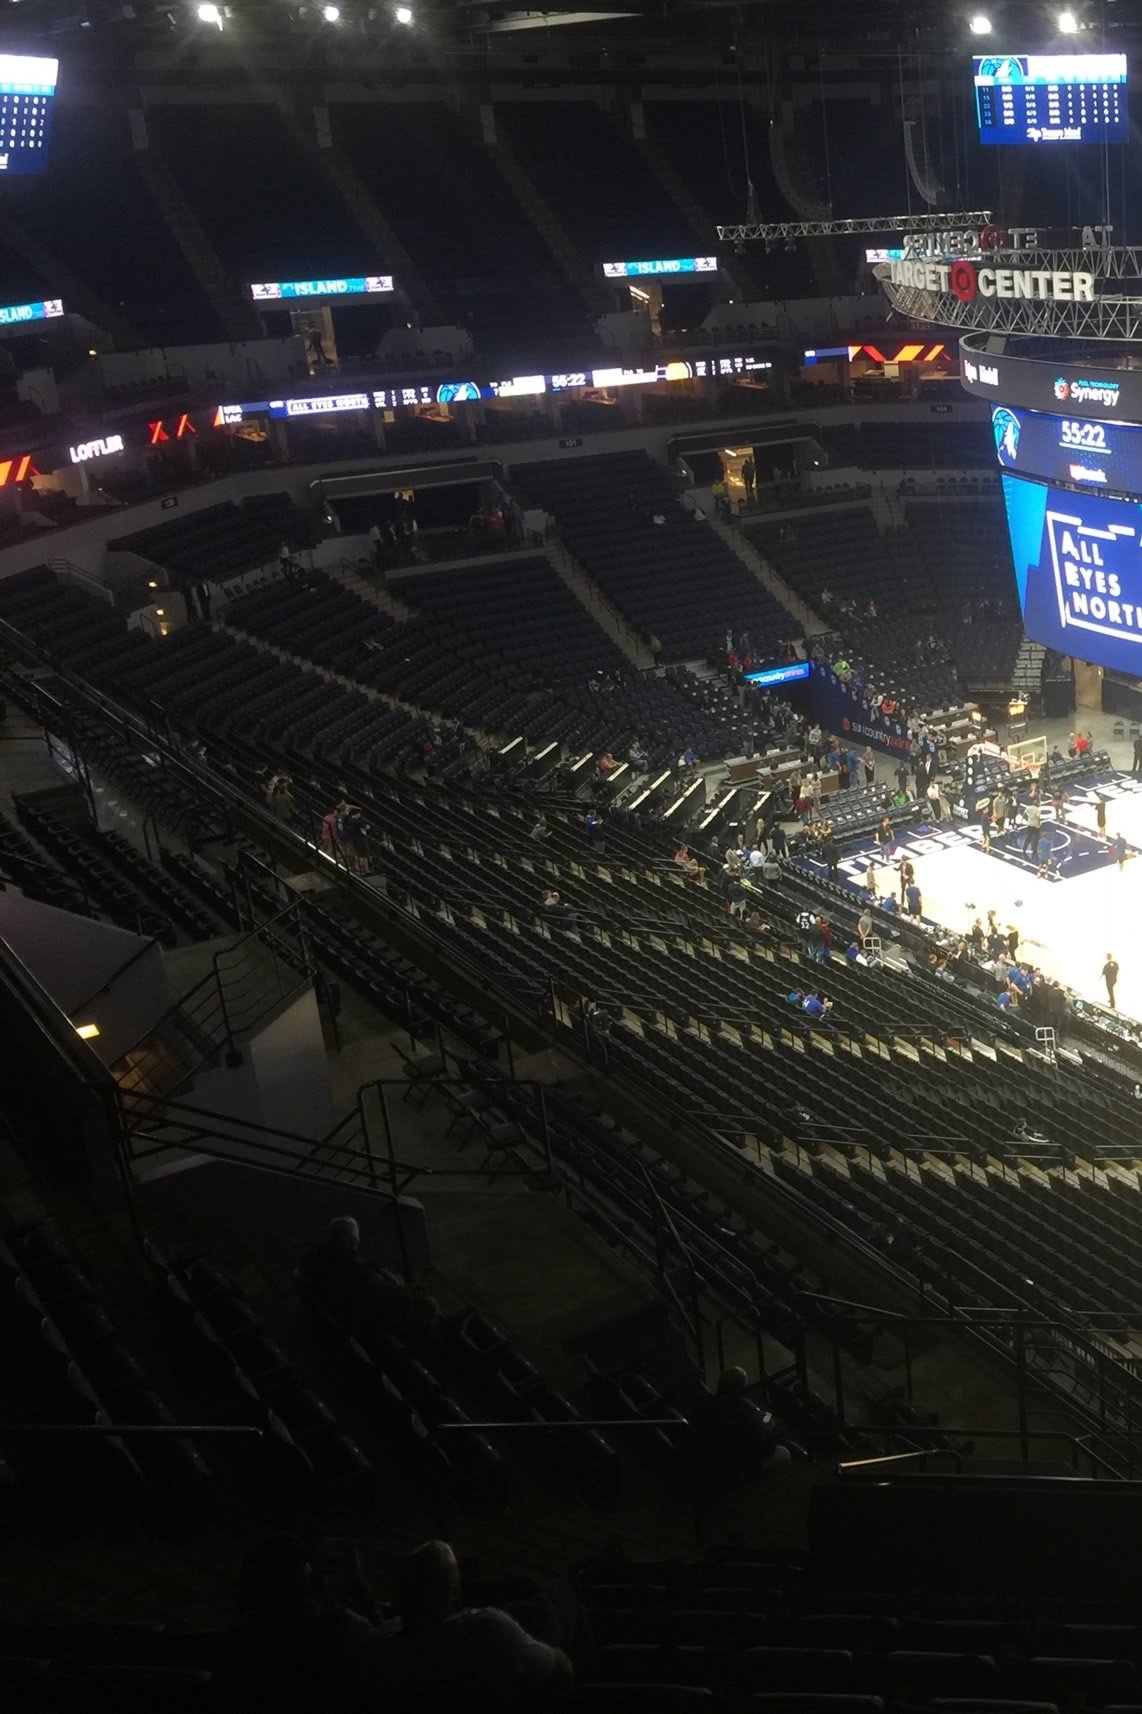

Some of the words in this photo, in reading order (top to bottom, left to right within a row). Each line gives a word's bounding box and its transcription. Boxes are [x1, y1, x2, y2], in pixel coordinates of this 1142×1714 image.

[638, 260, 680, 274] ISLAND
[294, 280, 348, 296] ISLAND
[887, 262, 952, 292] TARGET
[977, 268, 1096, 301] CENTER
[552, 373, 586, 388] 55:22
[1070, 382, 1120, 407] Synergy
[1061, 420, 1106, 448] 55:22
[69, 434, 124, 464] LOFFLER
[1061, 530, 1104, 566] ALL
[1063, 561, 1121, 597] EYES
